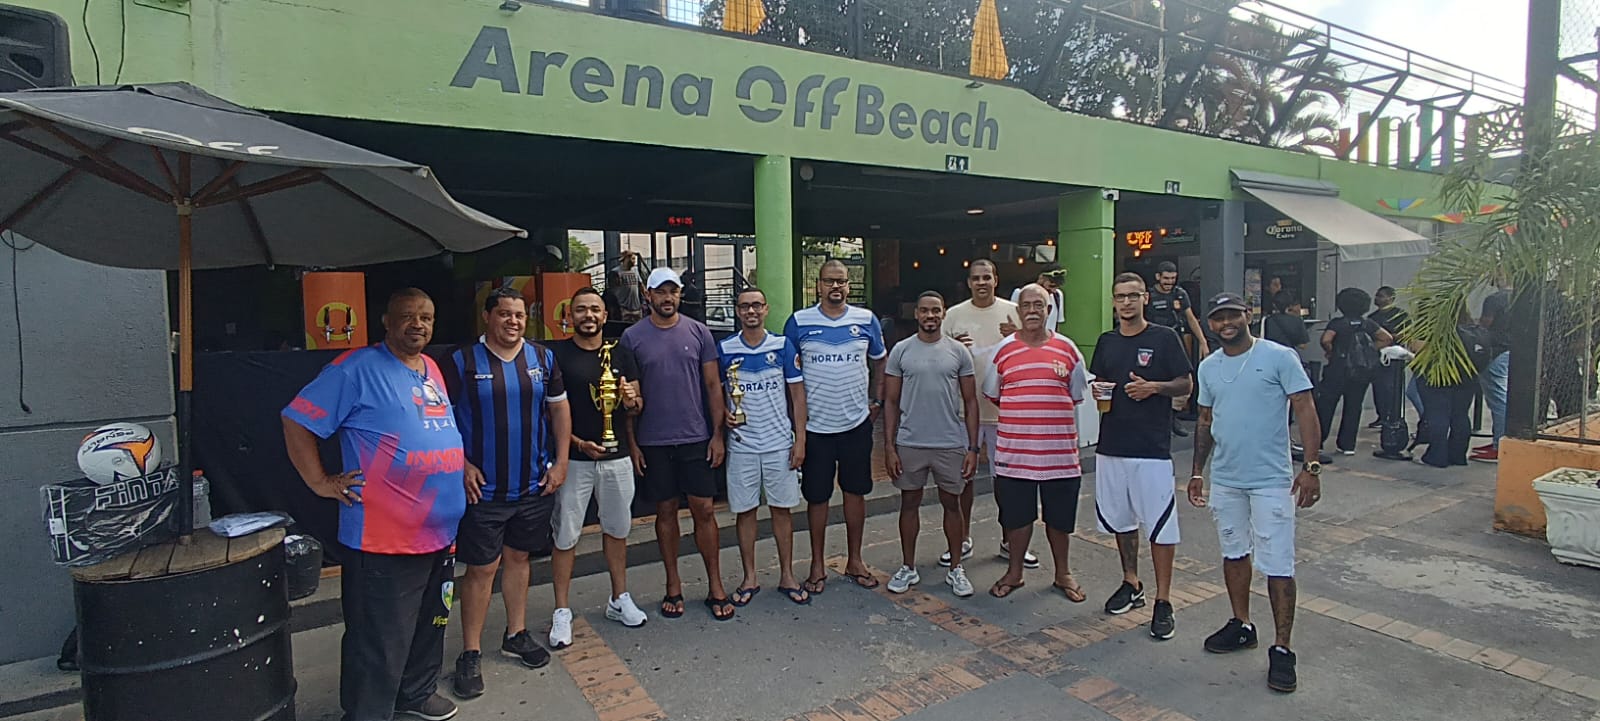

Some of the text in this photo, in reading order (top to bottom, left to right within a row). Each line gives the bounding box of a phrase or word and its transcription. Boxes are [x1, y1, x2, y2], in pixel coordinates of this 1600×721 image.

[450, 26, 713, 117] Arena
[855, 84, 999, 150] Beach
[1265, 225, 1303, 235] Corona
[811, 354, 844, 364] HORTA
[739, 382, 764, 393] ORTA
